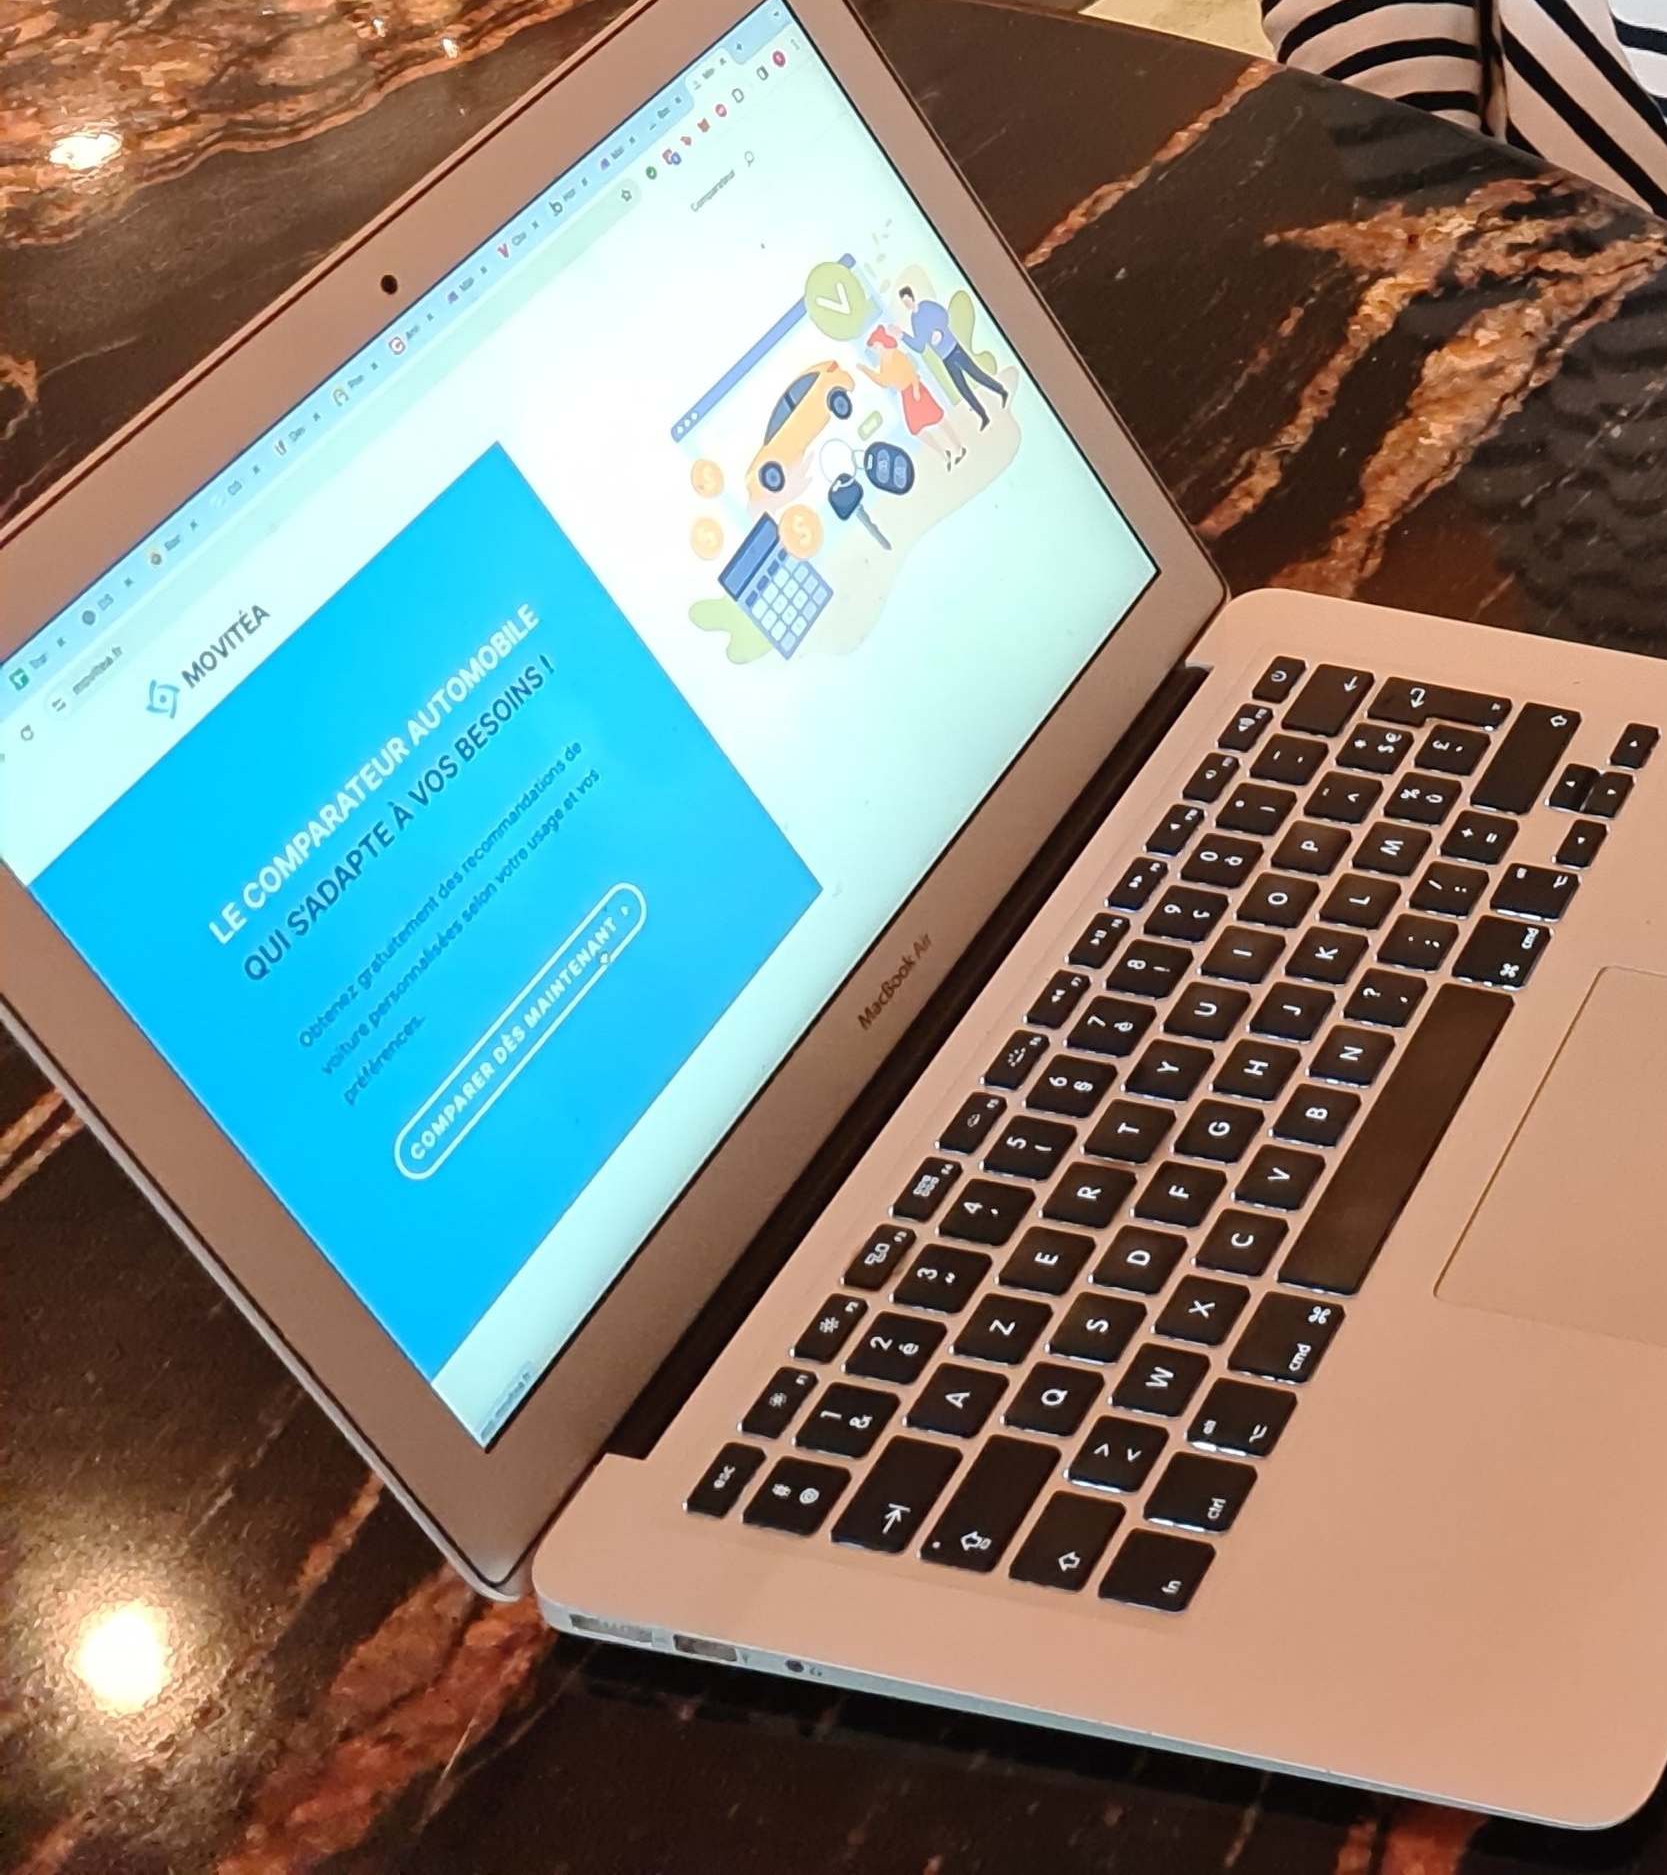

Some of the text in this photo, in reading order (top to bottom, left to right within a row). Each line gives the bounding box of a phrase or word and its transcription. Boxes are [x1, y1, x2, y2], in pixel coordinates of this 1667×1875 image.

[181, 605, 270, 688] MOVITÉA
[209, 603, 538, 943] LE COMPARATEUR AUTOMOBILE
[244, 929, 290, 980] QUI
[287, 820, 394, 935] S'ADAPTE
[387, 801, 413, 830] À
[407, 755, 457, 805] VOS
[454, 666, 543, 762] BESOINS
[1299, 839, 1319, 852] P
[1379, 839, 1404, 856] M
[1198, 850, 1219, 862] 0
[299, 742, 581, 1047] Obtenez gratuitement des recommandations de
[1266, 891, 1288, 905] O
[1348, 895, 1371, 905] L
[1163, 903, 1182, 914] 9
[321, 769, 599, 1074] voiture personnalisées selon votre usage et vos
[1520, 926, 1540, 950] cmd
[1231, 948, 1252, 957] I
[1313, 945, 1339, 960] K
[1125, 958, 1147, 970] 8
[856, 932, 933, 1031] MacBook Air
[1193, 1000, 1217, 1017] U
[1281, 1003, 1302, 1016] J
[1086, 1014, 1106, 1027] 7
[410, 916, 616, 1159] COMPARER DÈS MAINTENANT
[1338, 1044, 1363, 1061] N
[1155, 1060, 1179, 1072] Y
[1242, 1058, 1269, 1076] H
[1048, 1075, 1068, 1087] 6
[1304, 1106, 1328, 1121] B
[1116, 1121, 1140, 1134] T
[1207, 1120, 1231, 1137] G
[1005, 1135, 1027, 1149] 5
[1266, 1166, 1291, 1181] V
[1075, 1185, 1102, 1200] R
[1167, 1184, 1189, 1199] F
[962, 1200, 983, 1214] 4
[1230, 1231, 1254, 1248] C
[1033, 1251, 1059, 1266] E
[1125, 1248, 1151, 1266] D
[915, 1266, 938, 1281] 3
[1187, 1299, 1216, 1318] X
[988, 1318, 1016, 1336] Z
[1084, 1317, 1109, 1333] S
[868, 1335, 893, 1351] 2
[897, 1341, 919, 1355] é
[1287, 1342, 1312, 1372] cmd
[1144, 1365, 1174, 1388] W
[944, 1391, 970, 1409] A
[1040, 1387, 1068, 1407] Q
[819, 1409, 842, 1419] 1
[848, 1414, 873, 1429] &
[1206, 1497, 1226, 1520] ctrl
[1160, 1579, 1181, 1594] fn
